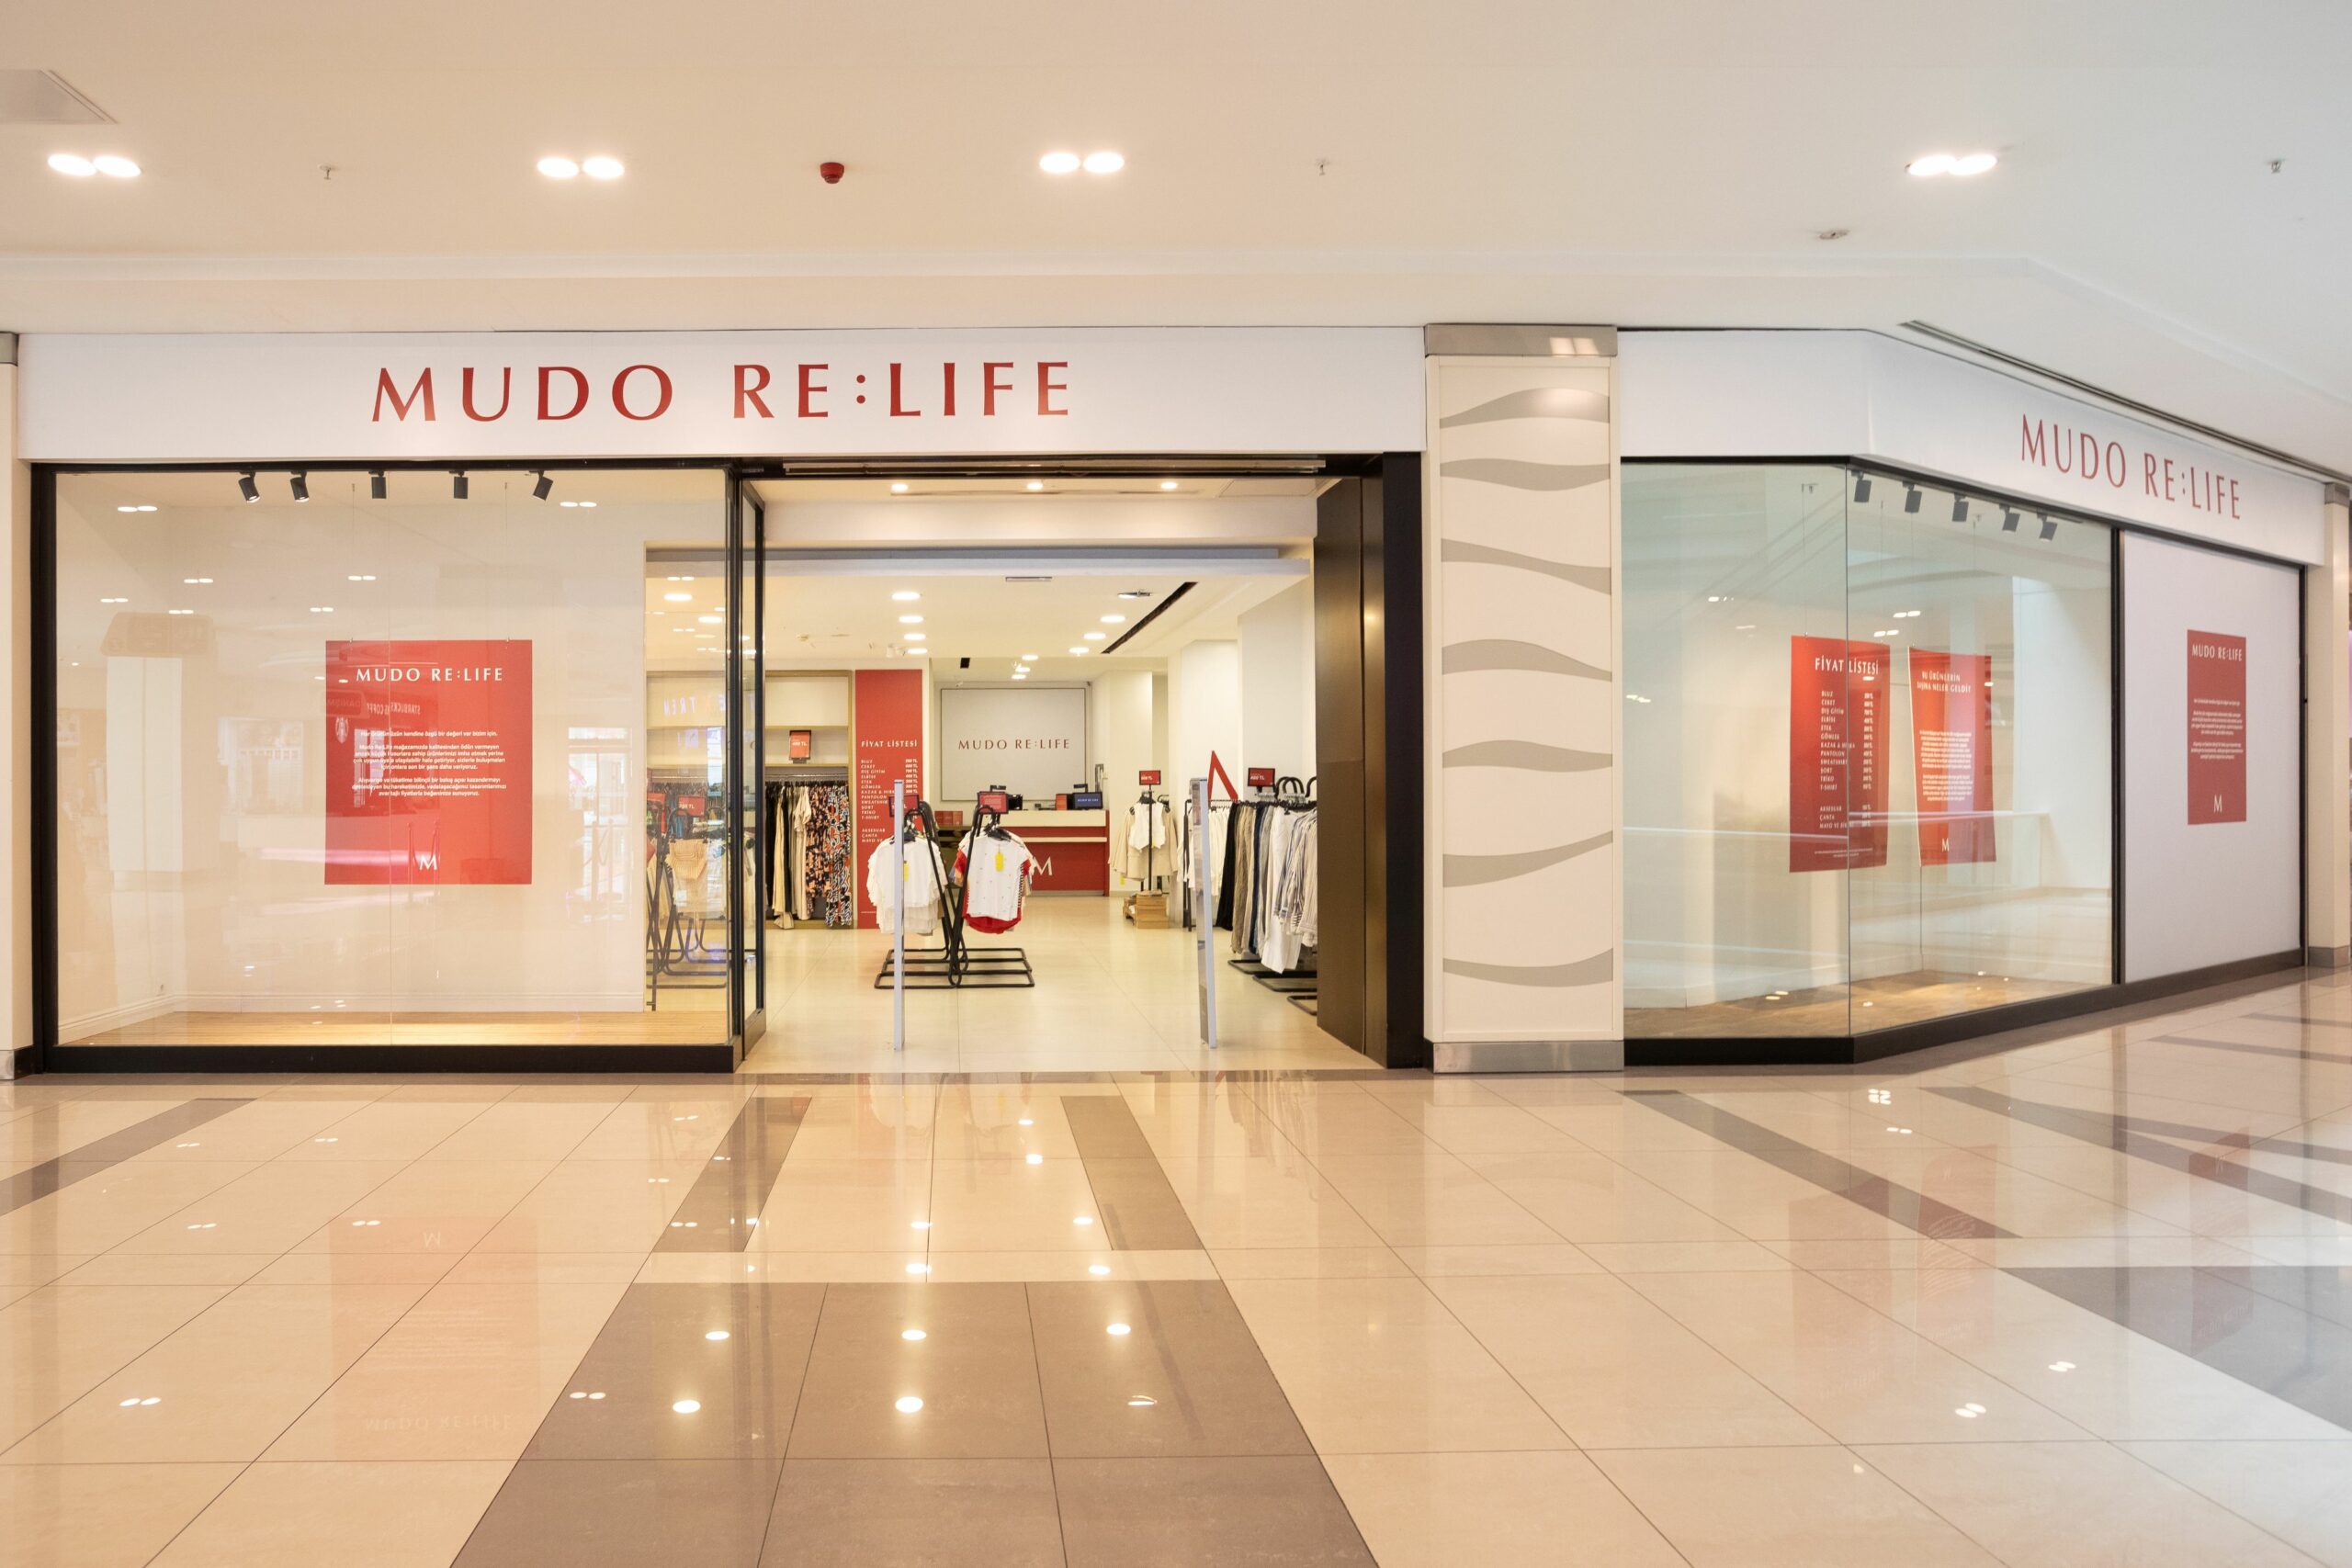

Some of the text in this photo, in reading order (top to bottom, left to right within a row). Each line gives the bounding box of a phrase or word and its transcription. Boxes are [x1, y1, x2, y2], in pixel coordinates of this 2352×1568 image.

[371, 361, 1069, 423] MUDO RE:LIFE
[2021, 413, 2241, 520] MUDO RE:LIFE
[2191, 644, 2243, 661] MUDO RE:LIFE
[1815, 655, 1879, 675] FİYAT LİSTESİ
[356, 668, 503, 682] MUDO RE:LIFE
[861, 739, 918, 748] FİYAT LİSTESİ
[958, 739, 1070, 750] MUDO RE:LIFE
[2213, 795, 2222, 813] M
[1941, 838, 1950, 852] M
[419, 854, 438, 870] M
